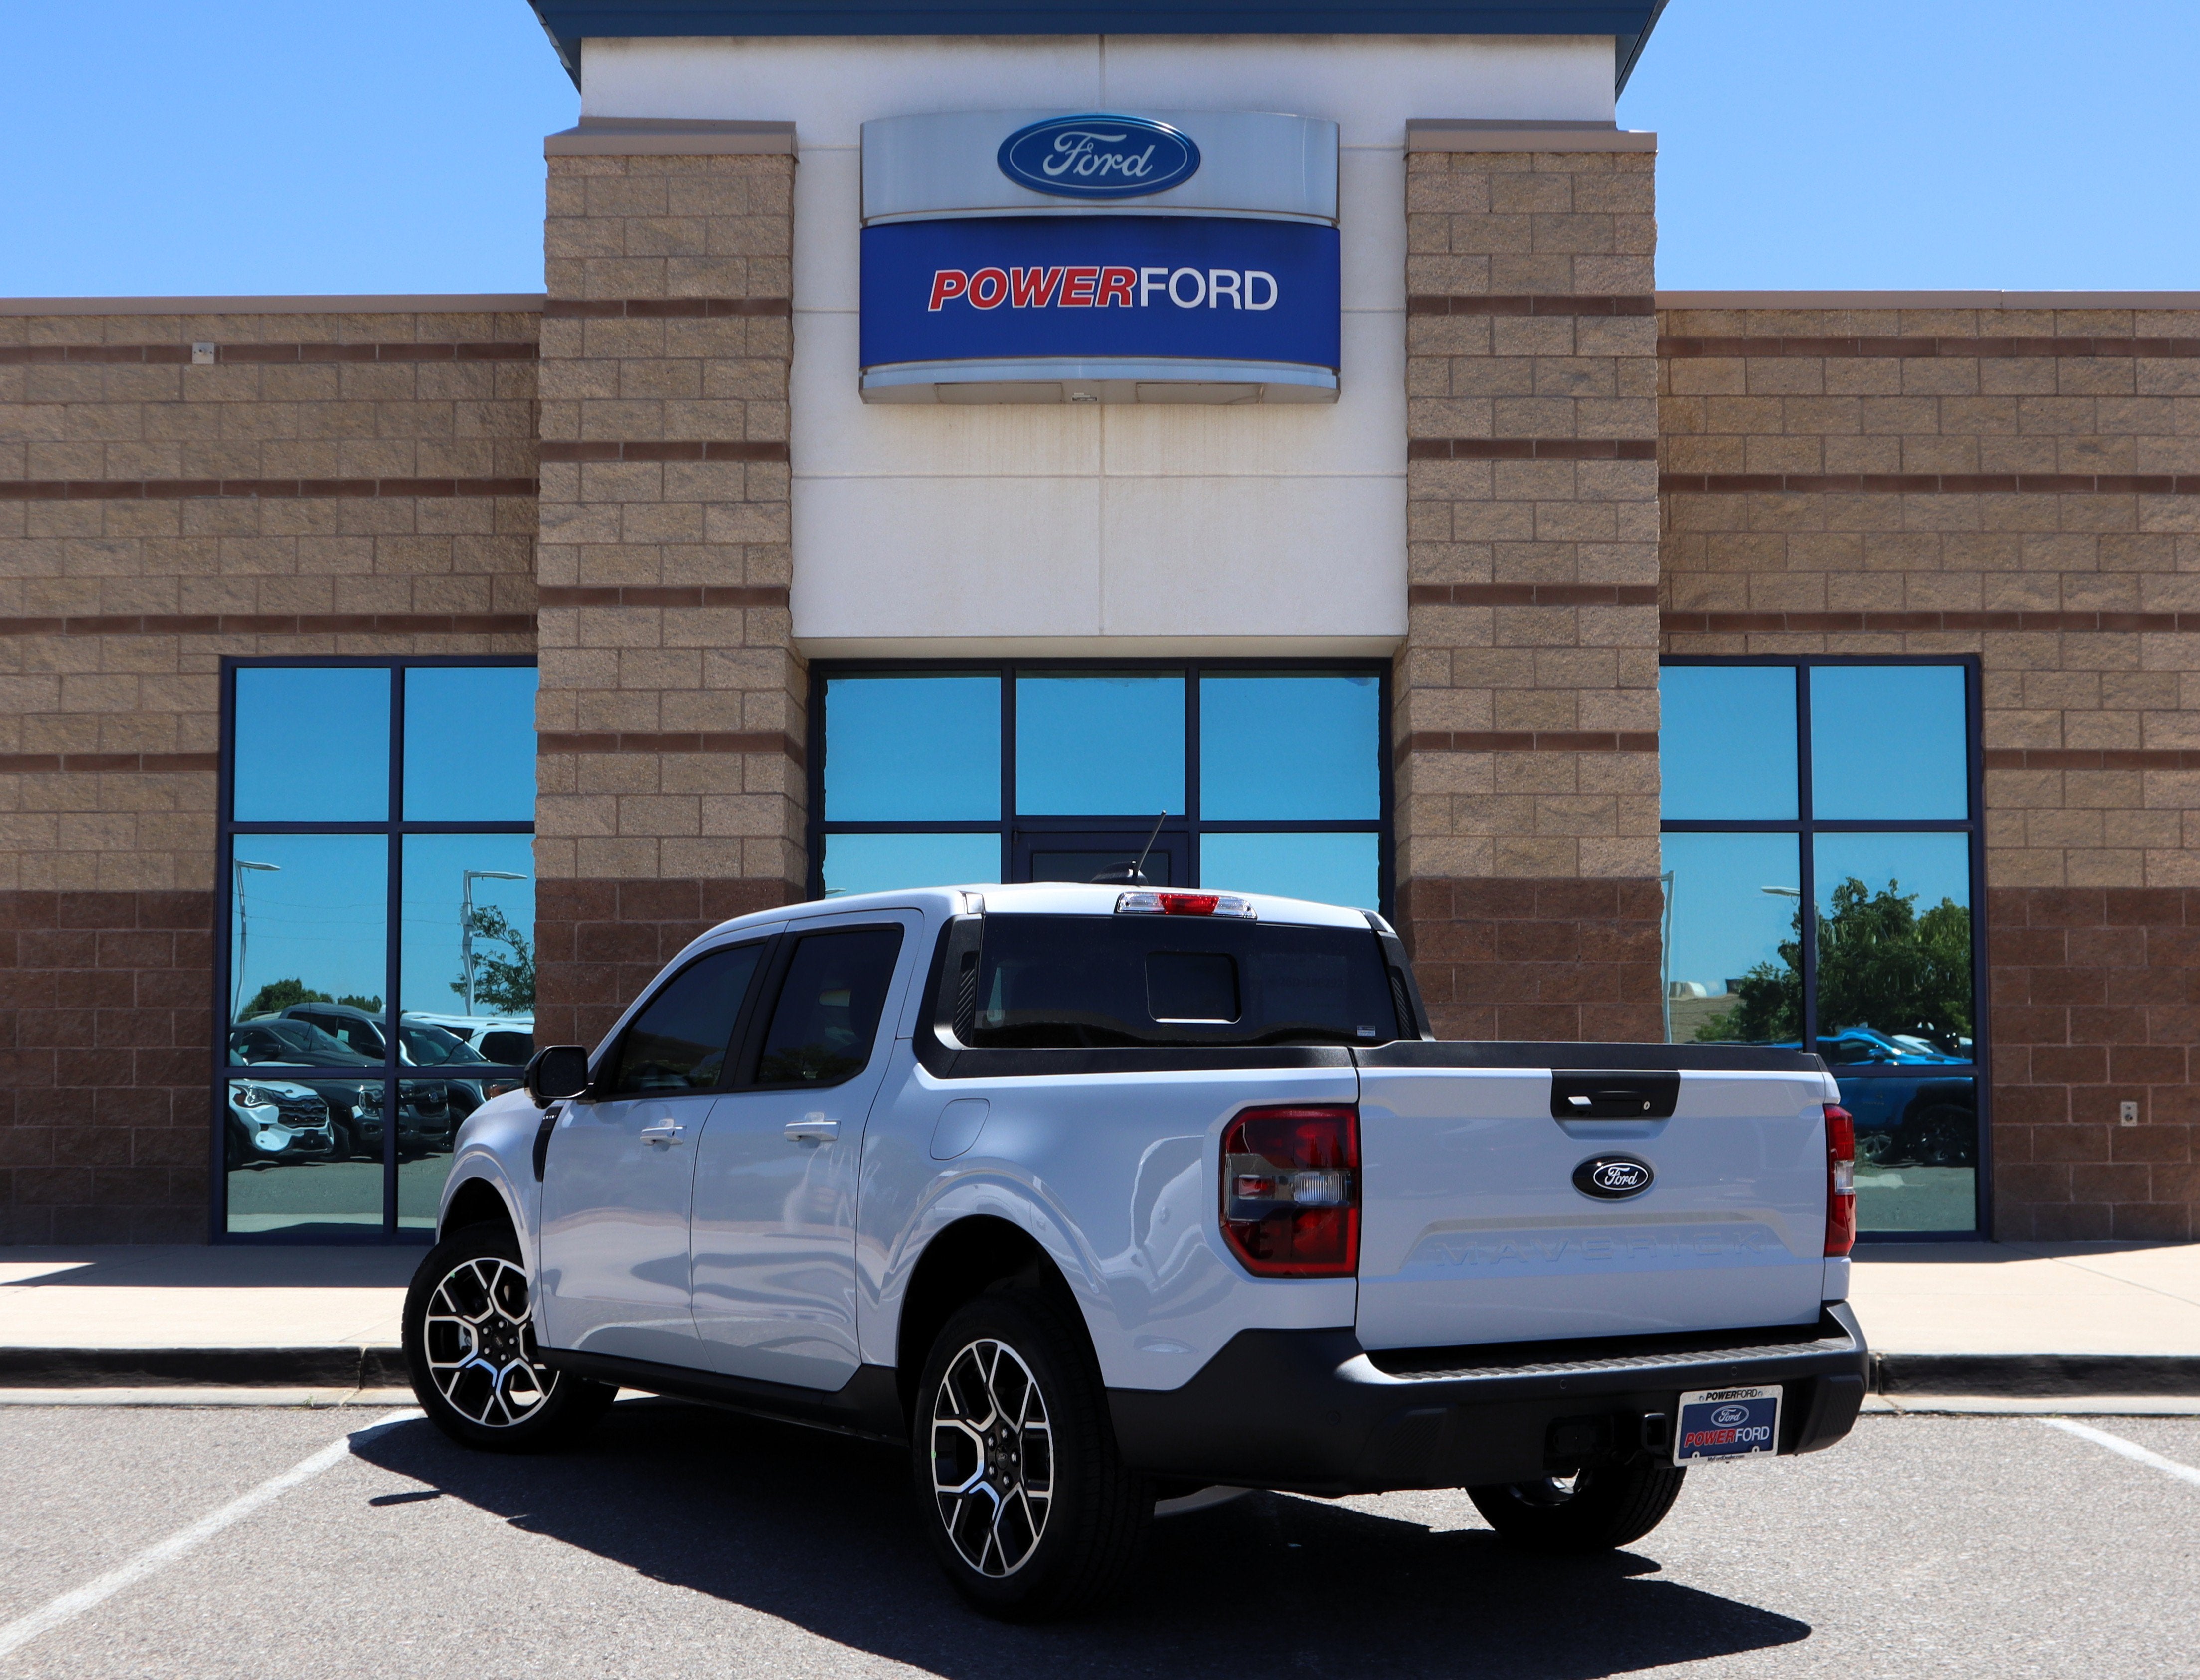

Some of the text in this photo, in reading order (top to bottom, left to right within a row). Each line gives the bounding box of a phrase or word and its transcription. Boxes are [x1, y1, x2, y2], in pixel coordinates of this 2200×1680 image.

[1042, 131, 1155, 177] Ford
[928, 266, 1278, 312] POWERFORD
[1604, 1166, 1638, 1186] Ford
[1435, 1231, 1764, 1267] MAVERICK
[1705, 1389, 1757, 1401] POWERFORD
[1718, 1409, 1741, 1422] Ford
[1684, 1426, 1769, 1448] POWERFORD
